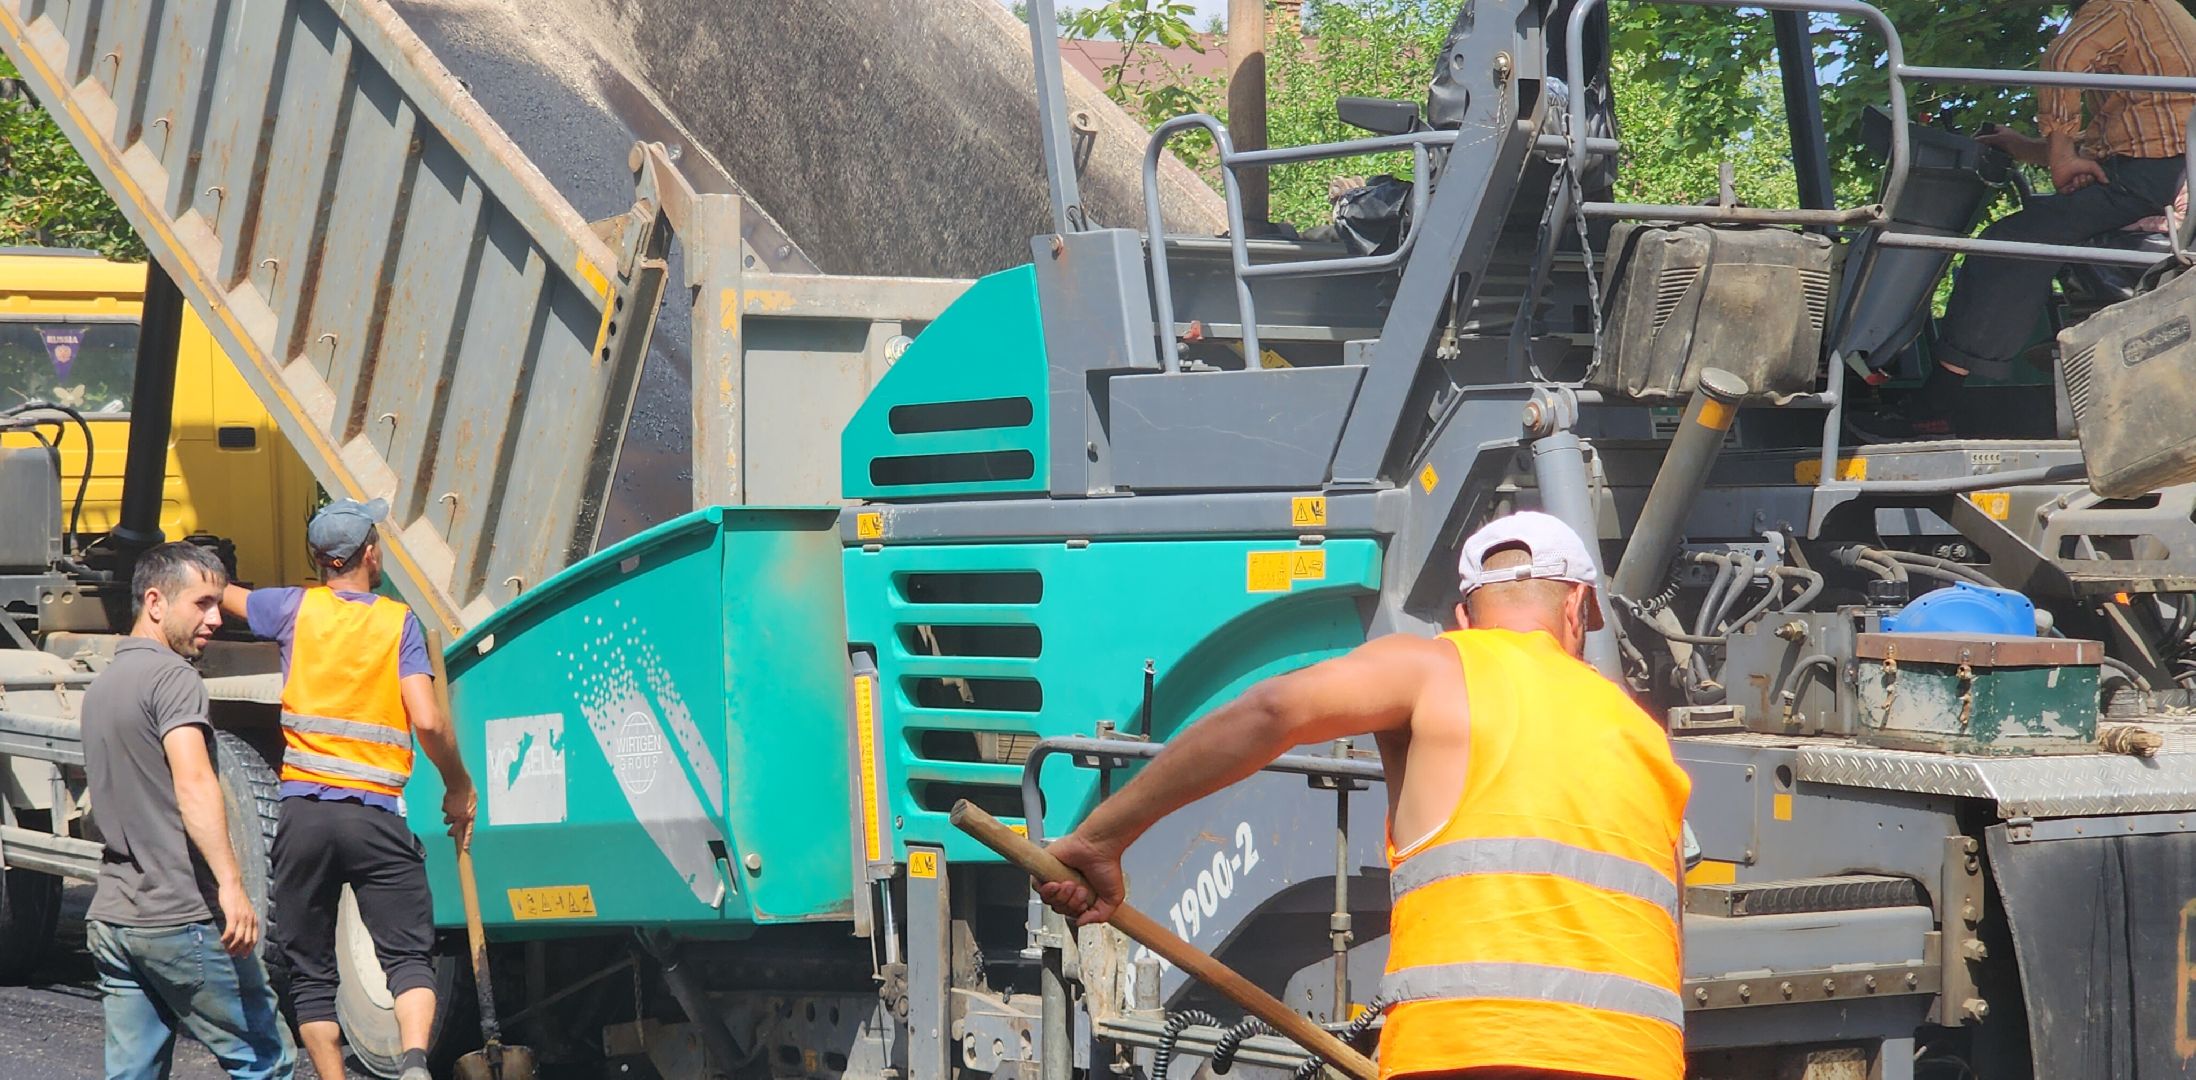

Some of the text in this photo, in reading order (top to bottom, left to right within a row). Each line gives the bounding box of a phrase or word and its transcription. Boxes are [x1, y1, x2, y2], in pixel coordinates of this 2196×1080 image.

[47, 335, 79, 344] RUSSIA
[616, 734, 662, 753] WIRTGEN
[620, 755, 658, 770] GROUP
[1169, 821, 1260, 943] 1900-2
